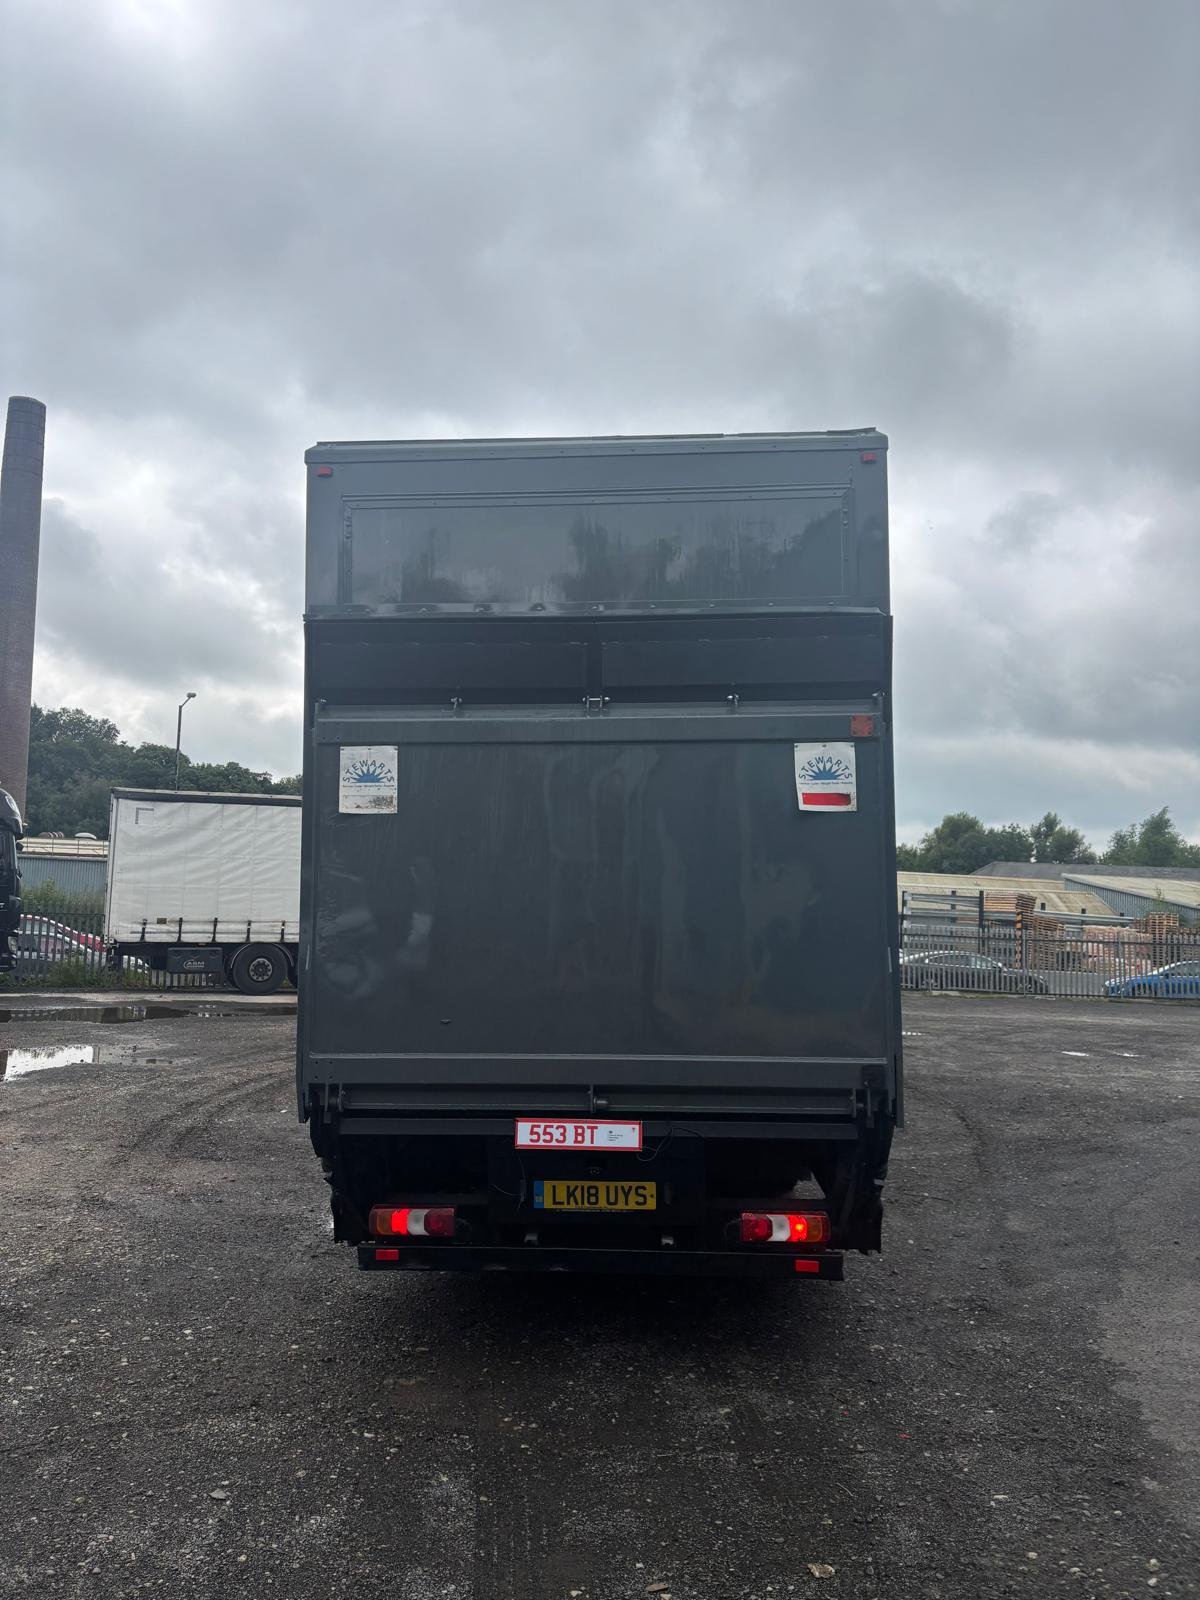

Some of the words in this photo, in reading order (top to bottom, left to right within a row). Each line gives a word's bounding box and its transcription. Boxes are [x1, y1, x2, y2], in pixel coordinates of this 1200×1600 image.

[343, 760, 395, 783] STEWARTS
[799, 756, 853, 780] STEWARTS
[529, 1124, 567, 1144] 553
[573, 1125, 599, 1145] BT
[552, 1184, 599, 1206] LK18
[606, 1185, 648, 1207] UYS
